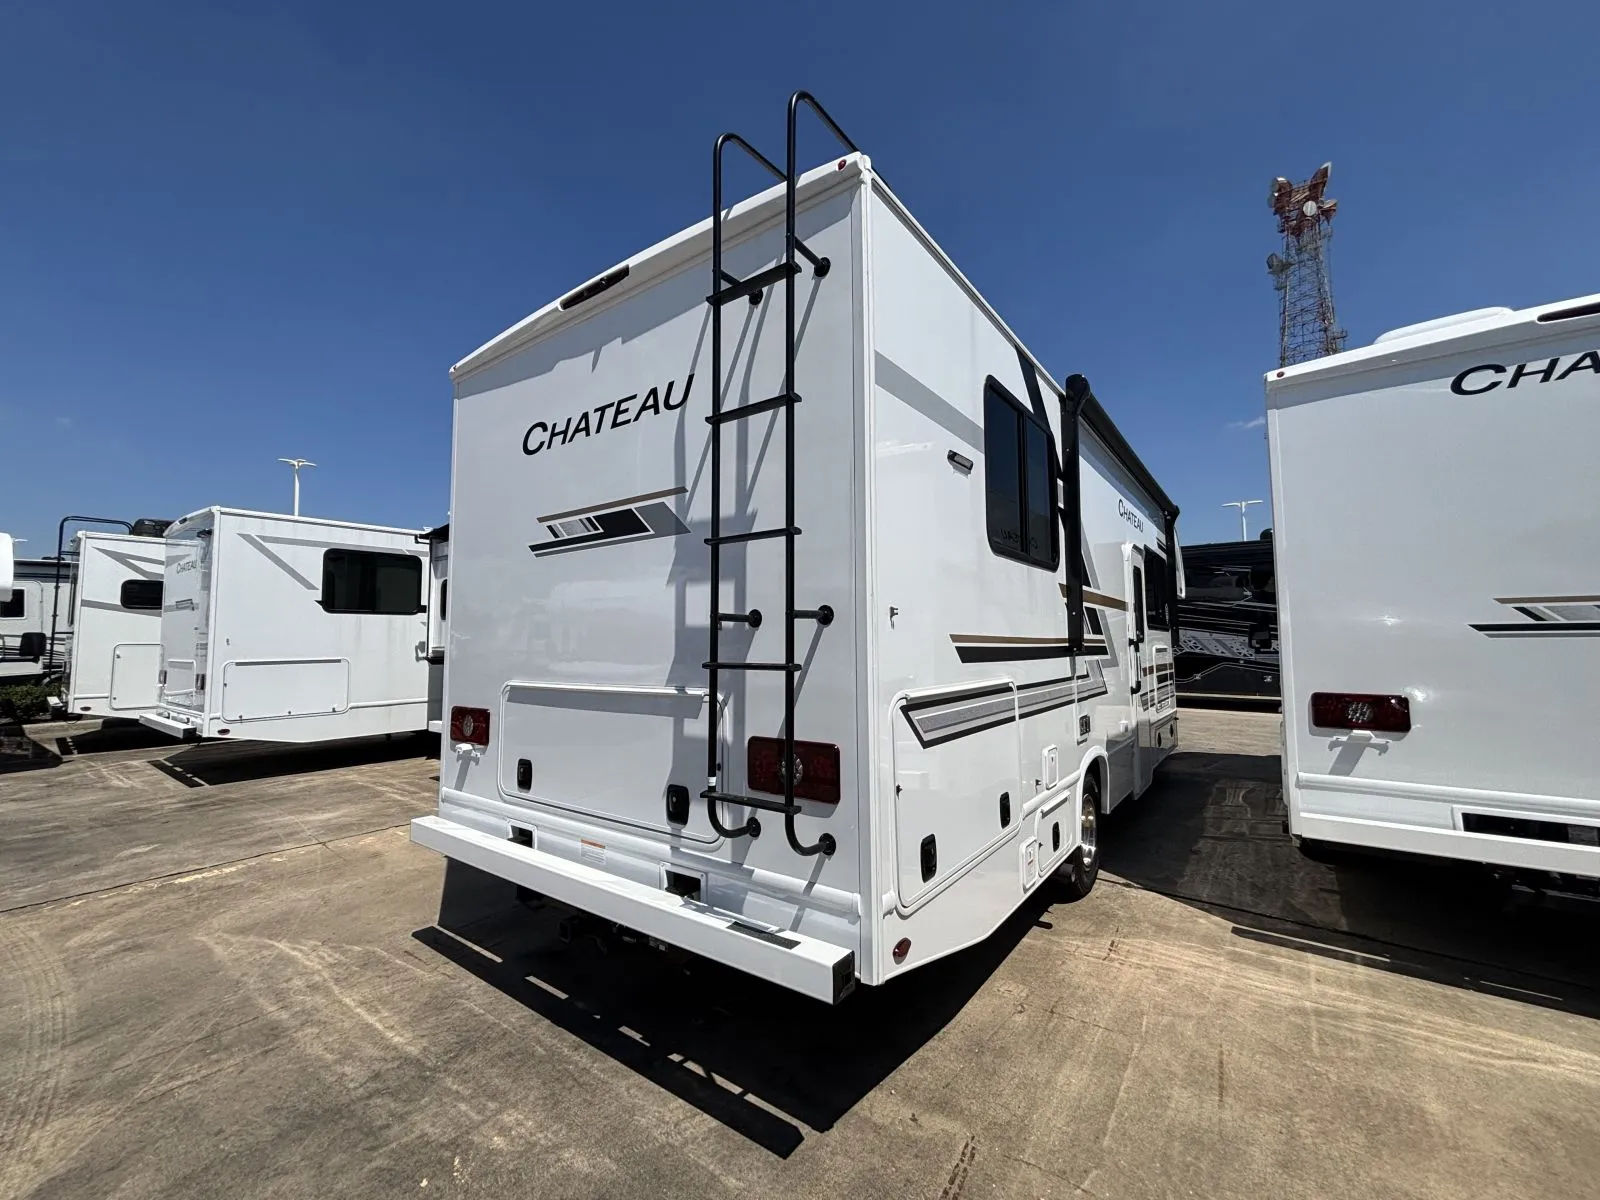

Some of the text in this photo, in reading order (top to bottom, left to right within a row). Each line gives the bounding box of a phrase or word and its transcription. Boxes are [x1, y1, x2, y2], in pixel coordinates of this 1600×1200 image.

[1450, 350, 1600, 396] CHA
[522, 373, 695, 456] CHATEAU
[1118, 498, 1144, 533] CHATEAU
